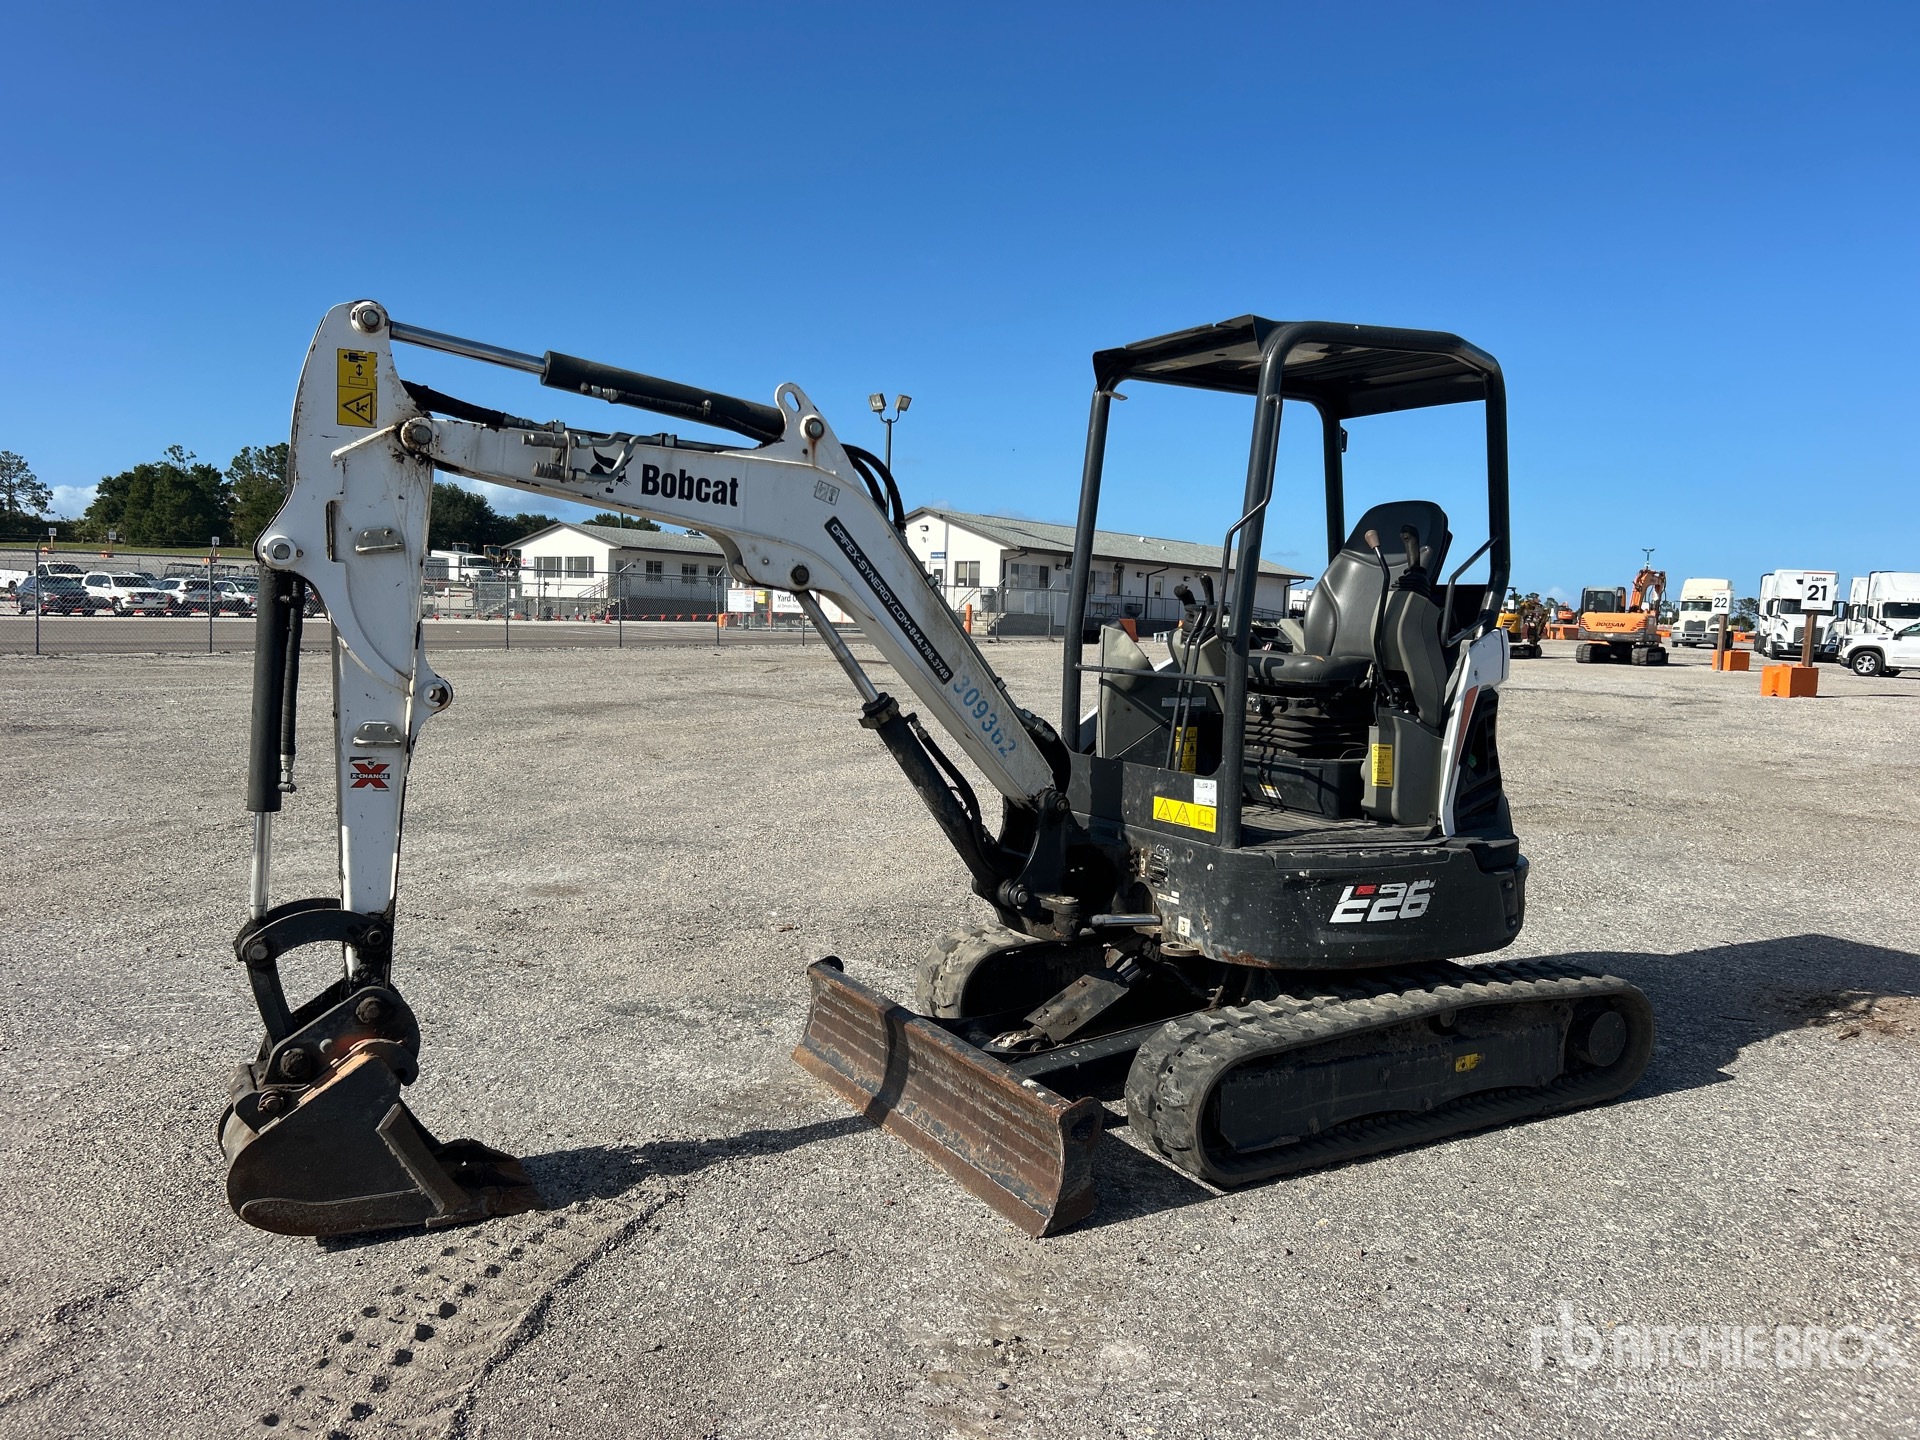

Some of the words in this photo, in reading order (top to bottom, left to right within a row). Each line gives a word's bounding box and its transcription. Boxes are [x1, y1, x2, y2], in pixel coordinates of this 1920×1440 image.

[641, 463, 739, 507] Bobcat
[777, 594, 791, 602] Yard
[1714, 597, 1728, 608] 22
[1807, 584, 1828, 601] 21
[953, 674, 1017, 758] 309362
[1328, 879, 1436, 924] E26
